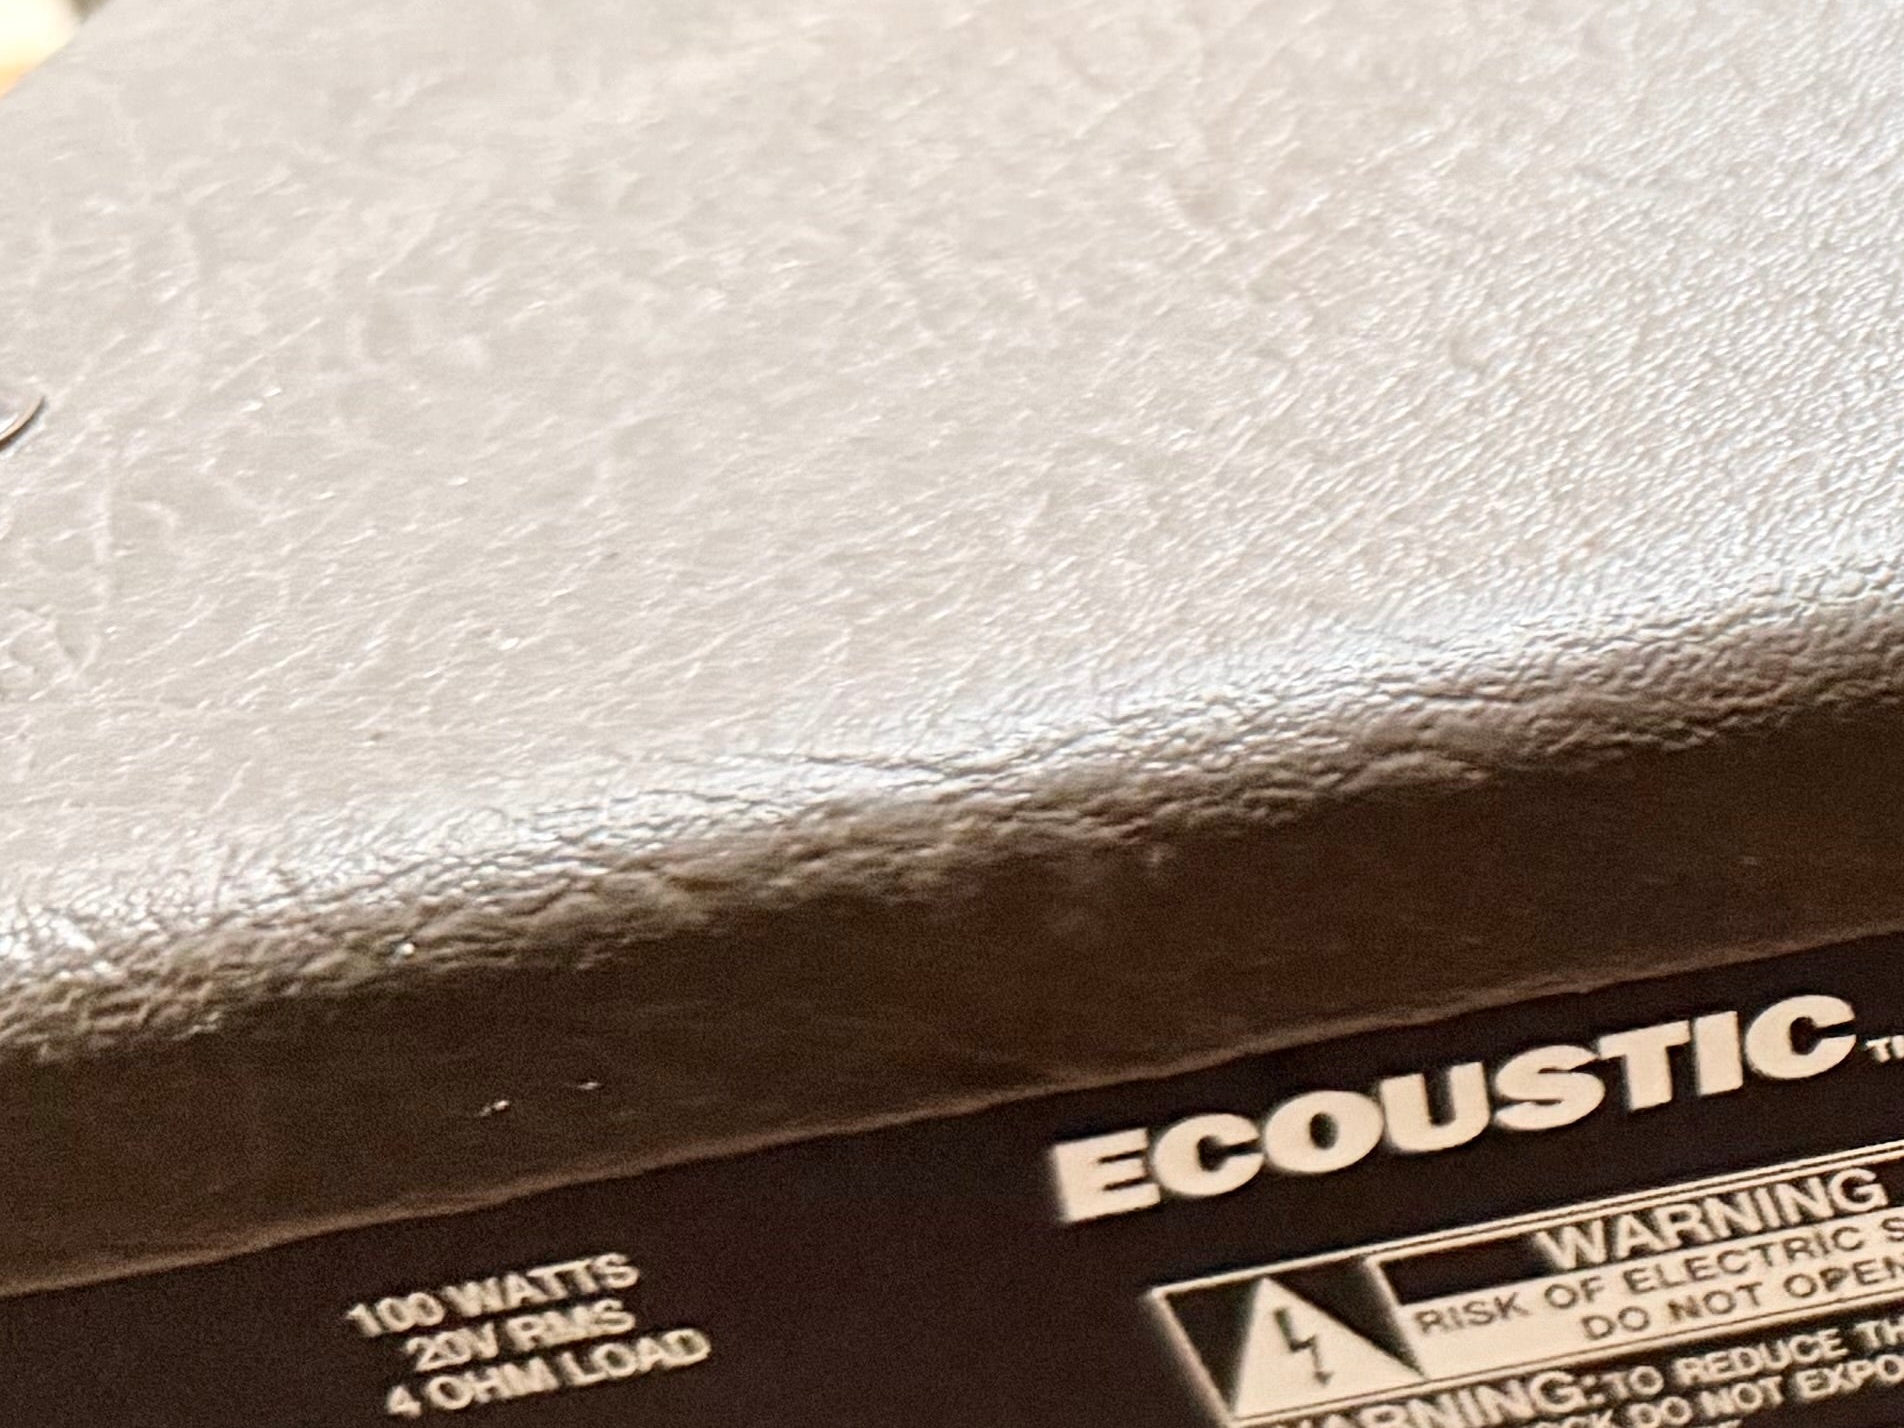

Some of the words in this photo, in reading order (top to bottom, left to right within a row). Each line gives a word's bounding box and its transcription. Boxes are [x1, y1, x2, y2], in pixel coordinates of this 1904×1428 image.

[1055, 994, 1858, 1225] ECOUSTIC
[1535, 1169, 1889, 1271] WARNING
[346, 1291, 446, 1337] 100
[441, 1252, 641, 1318] WATTS
[1413, 1291, 1530, 1338] RISK
[1543, 1276, 1606, 1312] OF
[1624, 1225, 1864, 1296] ELECTRIC
[1580, 1304, 1651, 1343] DO
[1668, 1278, 1770, 1324] NOT
[386, 1384, 423, 1419] 4
[423, 1355, 560, 1411] OHM
[559, 1327, 713, 1387] LOAD
[402, 1323, 500, 1372] 20V
[505, 1298, 637, 1353] RMS
[1671, 1327, 1849, 1387] REDUCE
[1700, 1374, 1789, 1419] NOT
